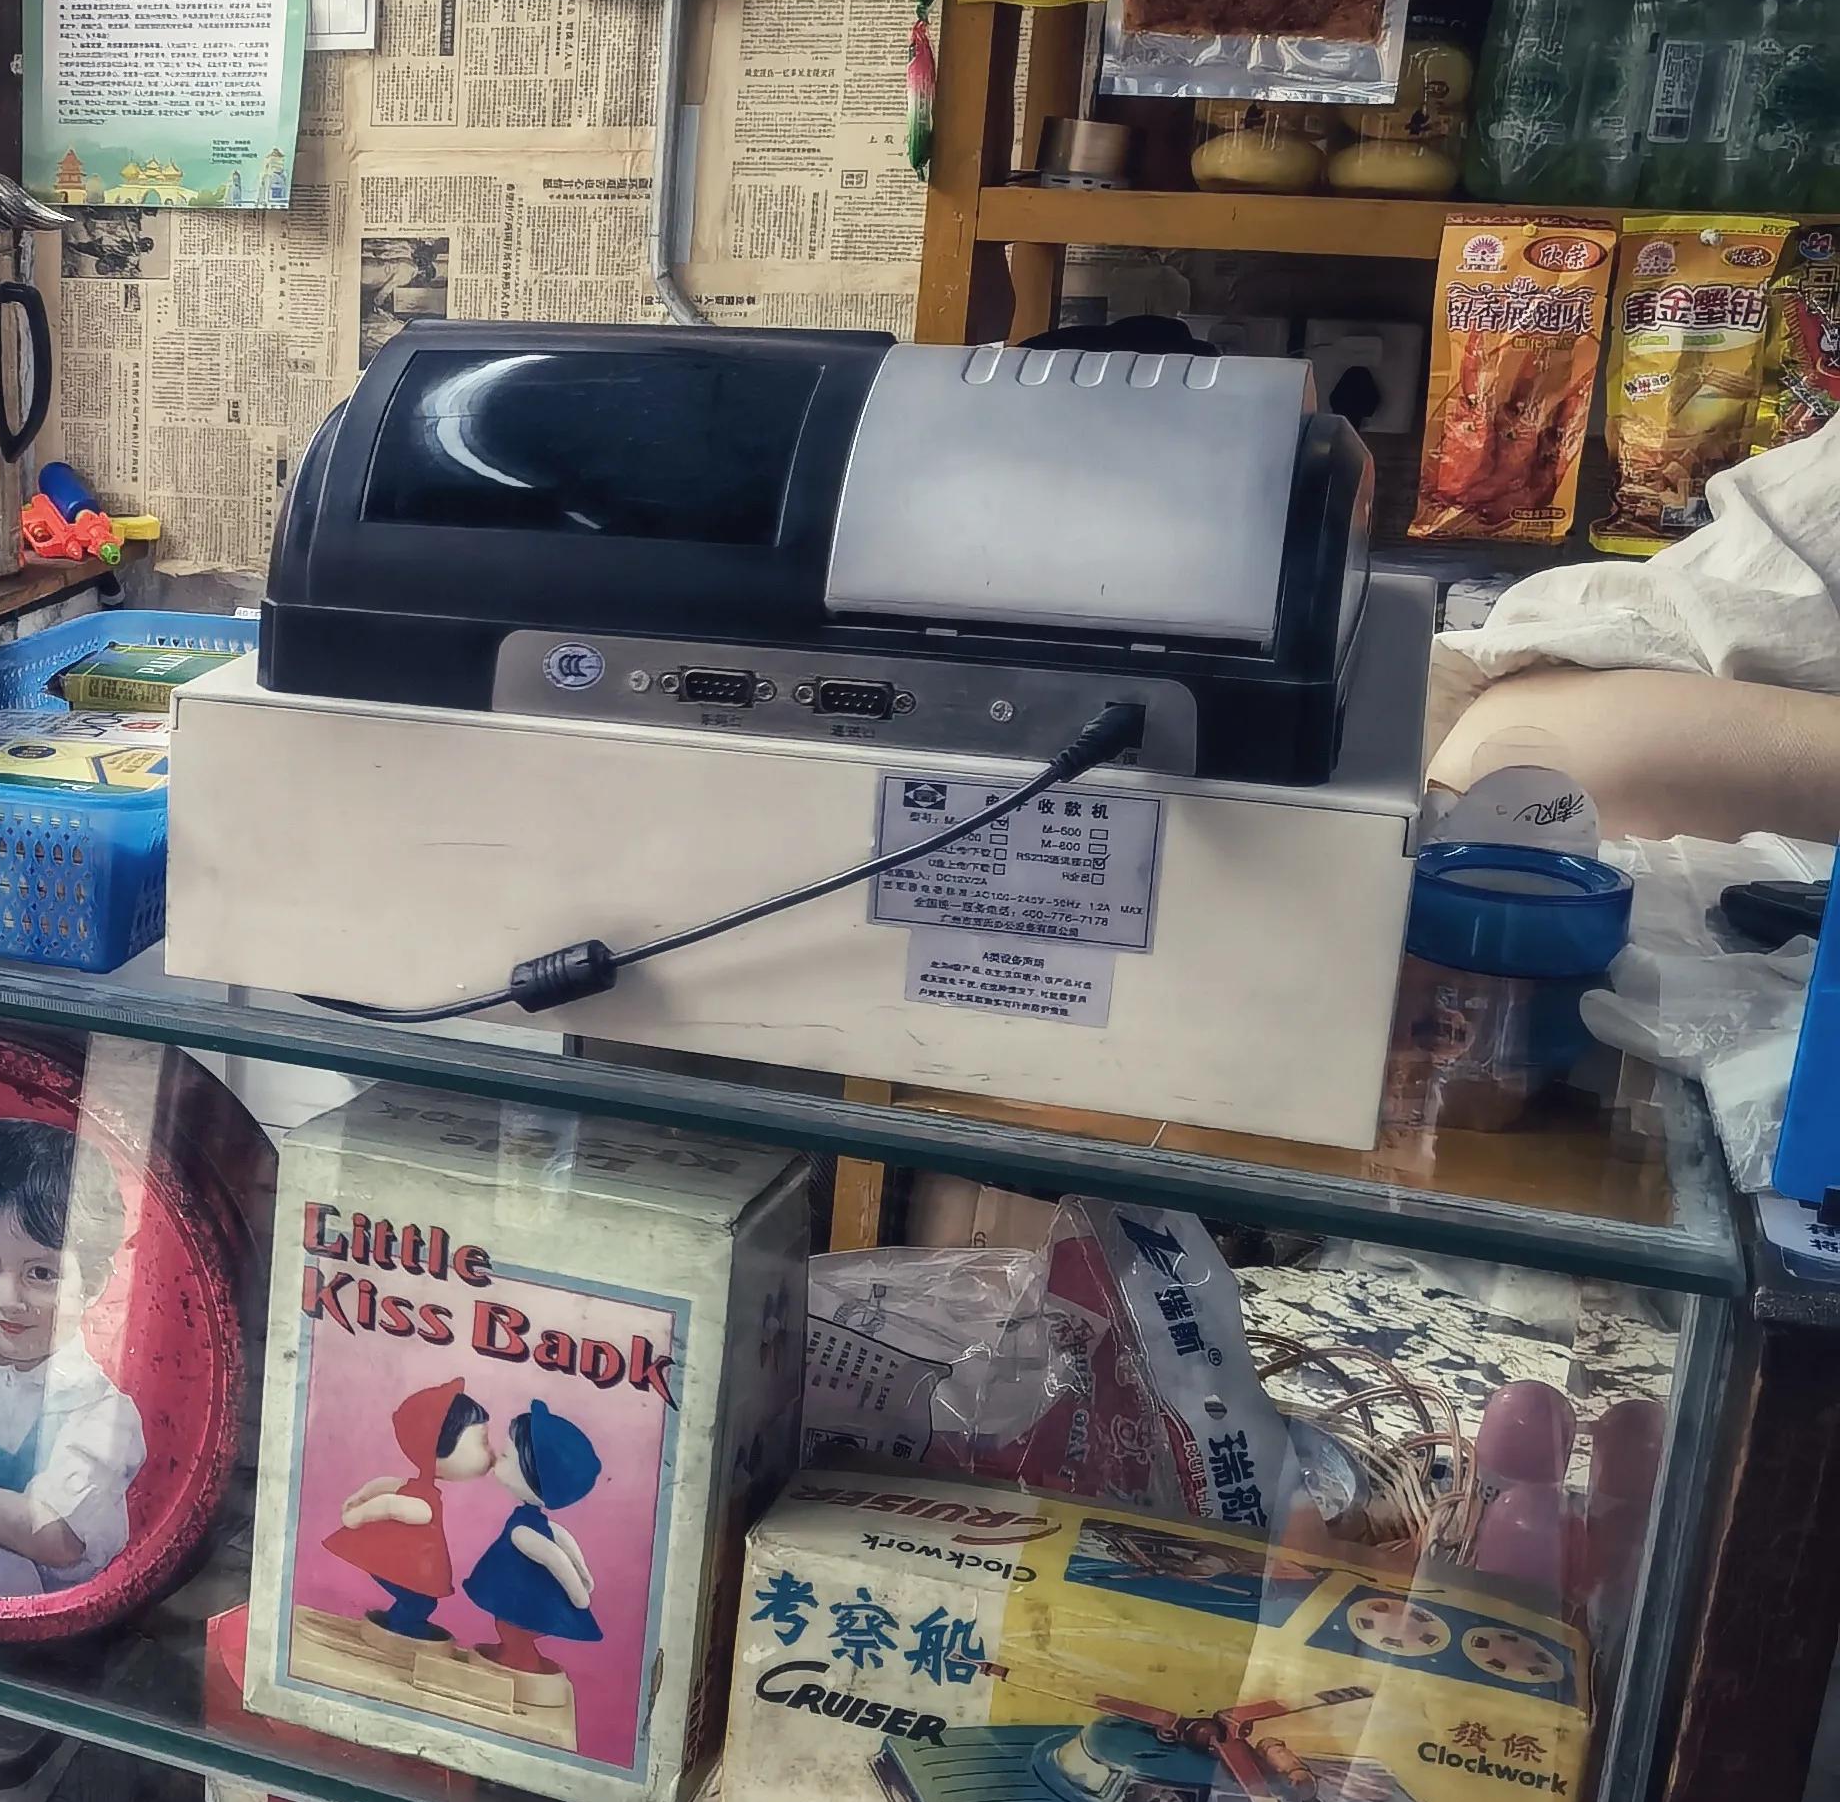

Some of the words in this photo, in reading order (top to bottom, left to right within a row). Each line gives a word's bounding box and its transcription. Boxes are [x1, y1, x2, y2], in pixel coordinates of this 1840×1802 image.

[1539, 242, 1590, 269] 欣荣
[986, 794, 1109, 820] 电收款机
[303, 1201, 494, 1288] Little
[301, 1265, 457, 1337] Kiss
[473, 1299, 681, 1412] Bank
[861, 1529, 1037, 1585] Clockwork
[749, 1572, 988, 1687] 考察船
[754, 1659, 949, 1747] CRUISER
[1416, 1741, 1569, 1796] Clockwork
